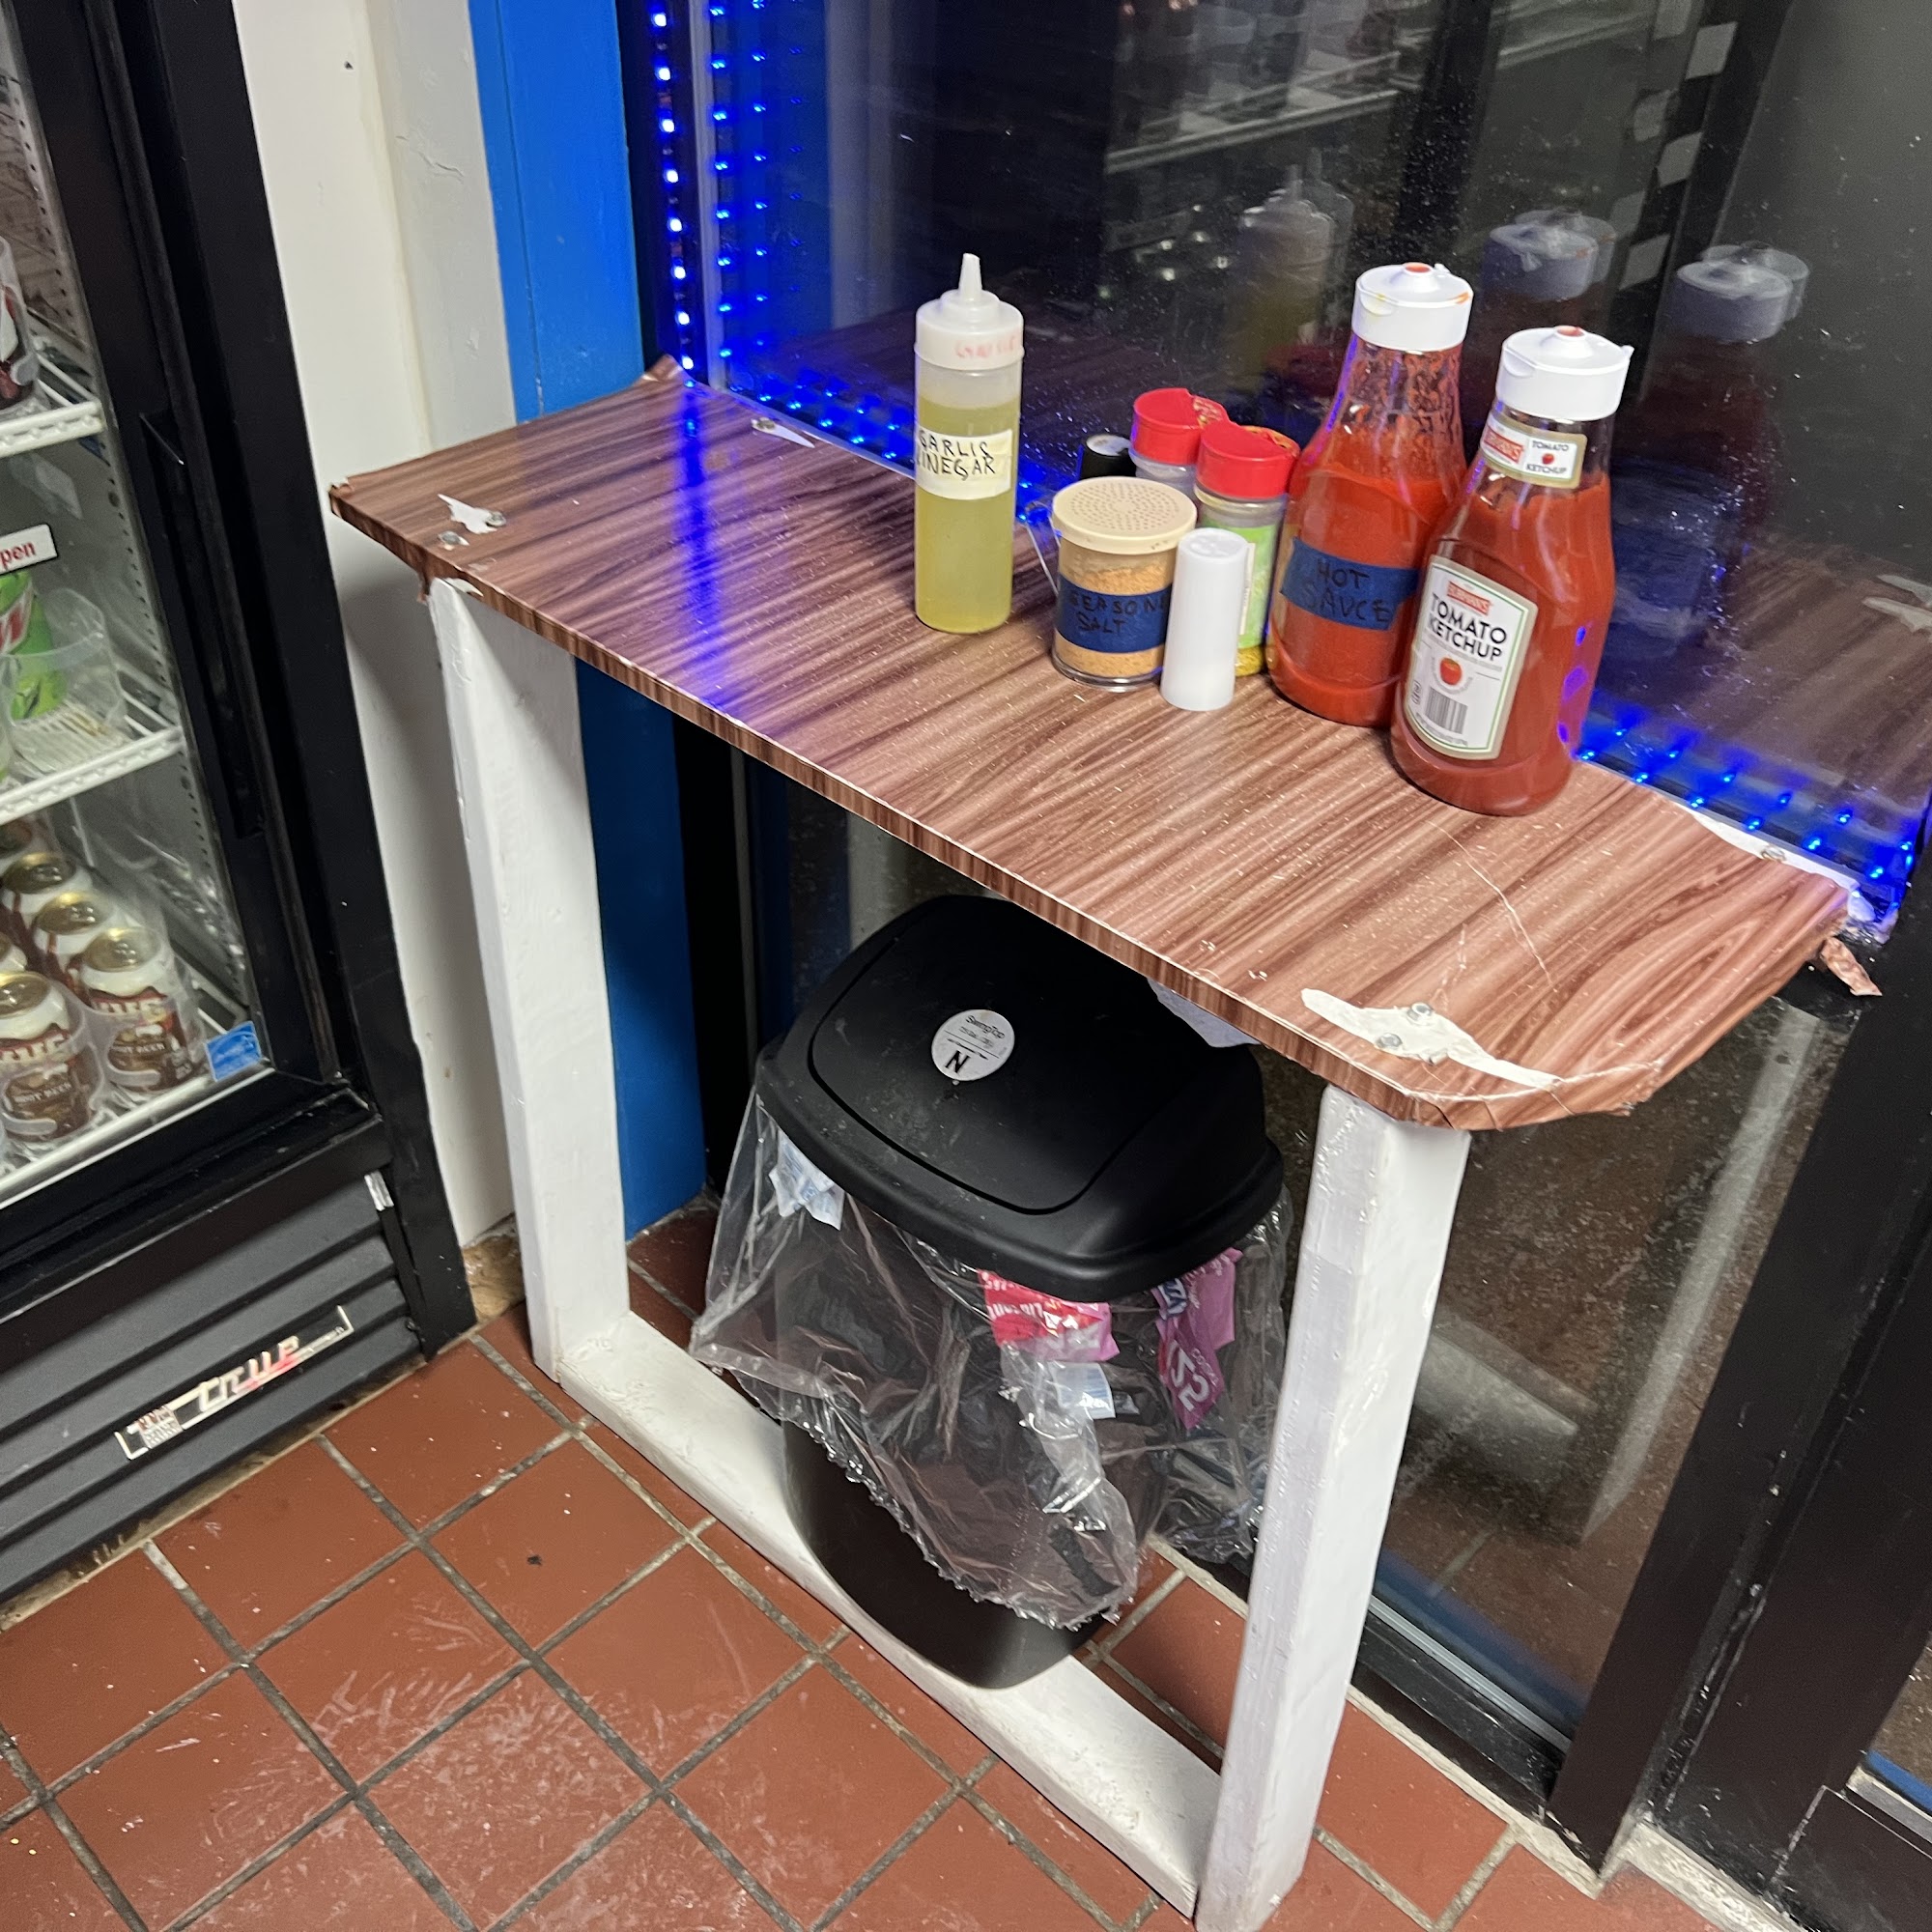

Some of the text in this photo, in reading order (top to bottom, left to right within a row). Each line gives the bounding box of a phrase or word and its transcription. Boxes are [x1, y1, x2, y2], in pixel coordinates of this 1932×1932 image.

[918, 430, 990, 458] GARLIC
[1531, 440, 1570, 452] TOMATO
[1526, 464, 1567, 474] KETCHUP
[1317, 559, 1370, 589] HOT
[1076, 611, 1127, 635] SALT
[1432, 592, 1507, 644] TOMATO
[1428, 612, 1502, 662] KETCHUP
